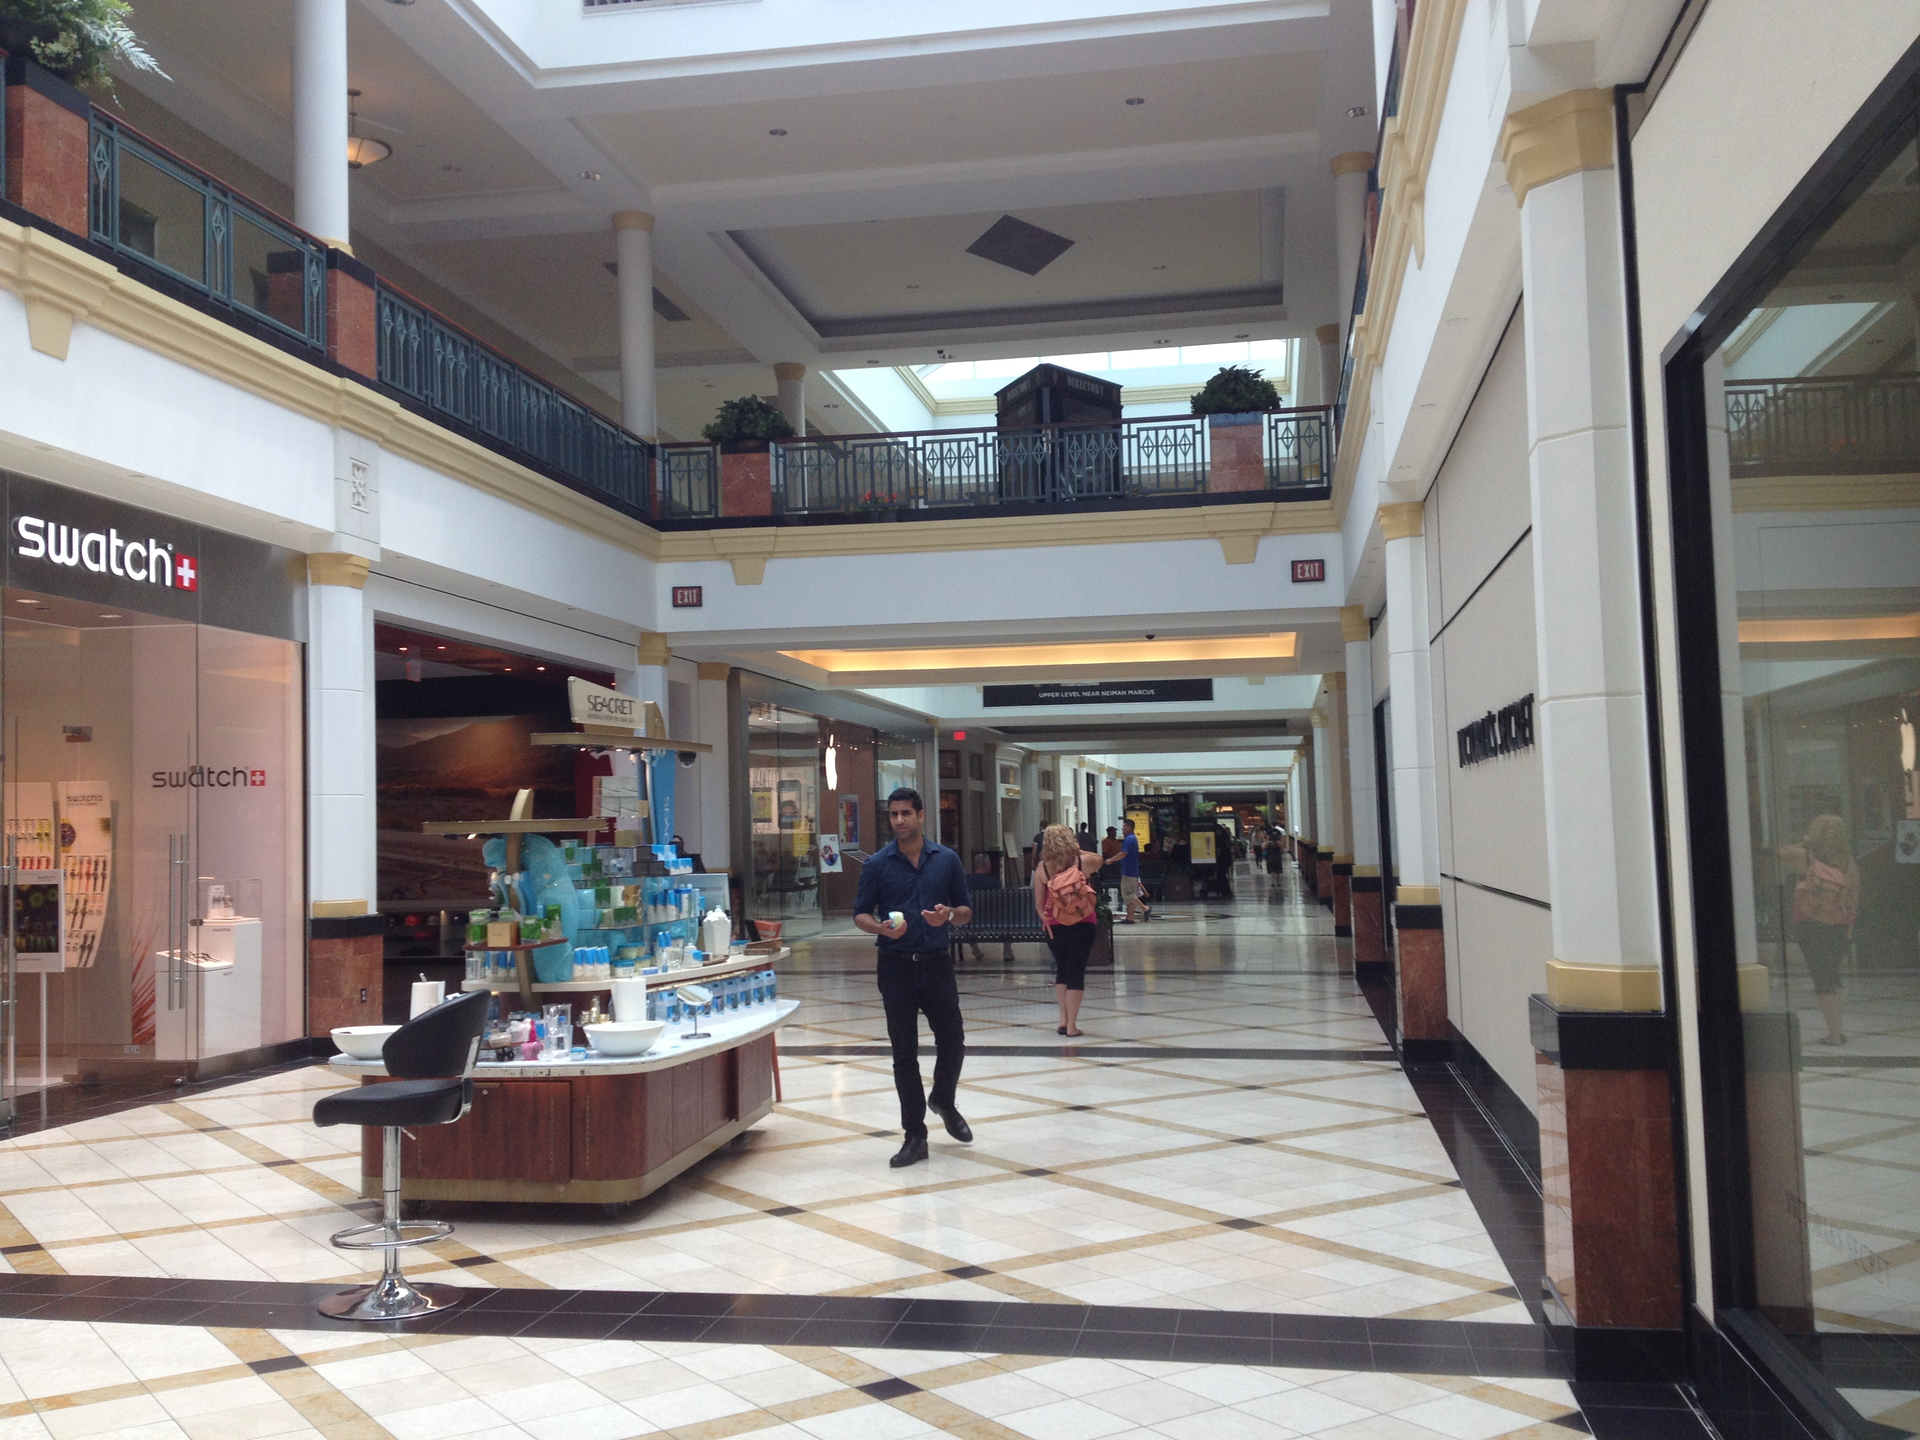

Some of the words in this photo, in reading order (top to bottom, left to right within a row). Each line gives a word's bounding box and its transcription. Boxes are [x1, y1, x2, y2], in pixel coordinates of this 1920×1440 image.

[1067, 375, 1104, 396] DIRECTORY
[18, 514, 172, 587] swatch
[1297, 563, 1319, 579] EXIT
[677, 589, 698, 604] EXIT
[587, 694, 635, 716] SEACRET
[152, 766, 248, 788] swatch
